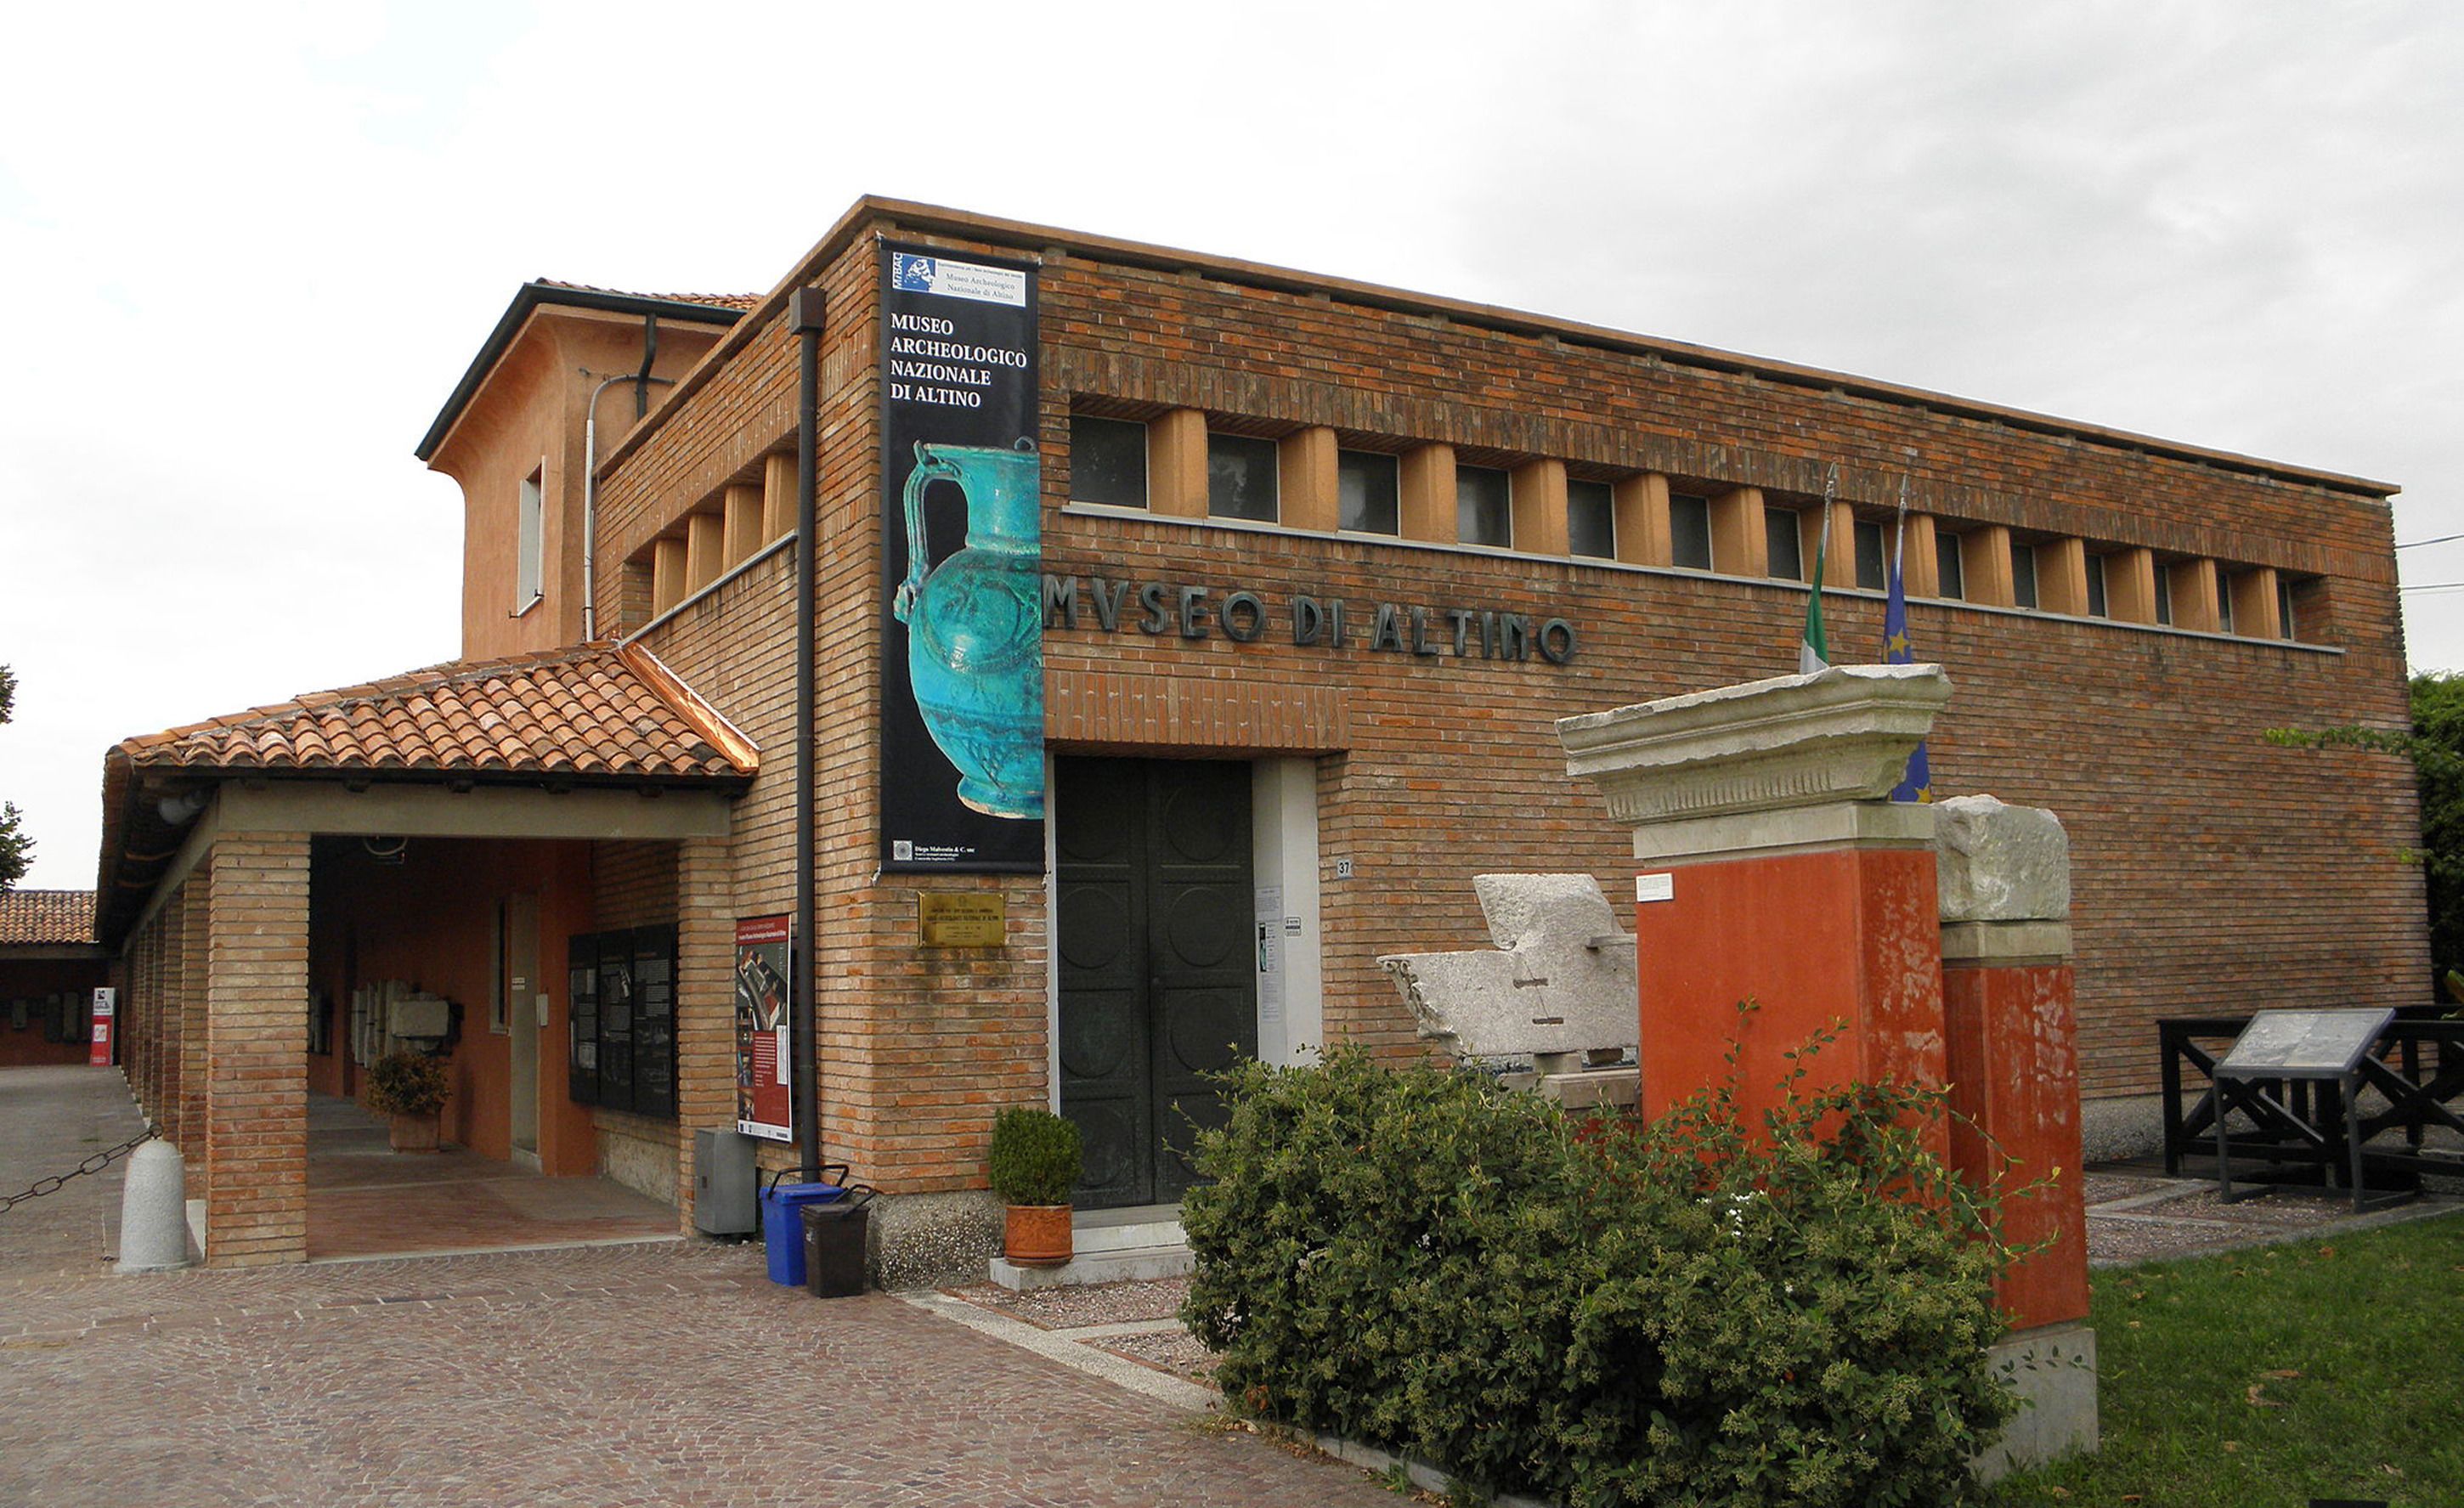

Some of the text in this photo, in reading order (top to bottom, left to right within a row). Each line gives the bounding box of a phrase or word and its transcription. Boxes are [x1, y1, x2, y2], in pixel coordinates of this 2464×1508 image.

[946, 273, 969, 283] Museo
[890, 313, 954, 336] MUSEO
[890, 336, 1027, 368] ARCHEOLOGICO
[890, 360, 992, 386] NAZIONALE
[890, 383, 981, 408] DI ALTINO
[1042, 574, 1577, 664] MVSEO DI ALTINO
[1339, 861, 1350, 874] 37
